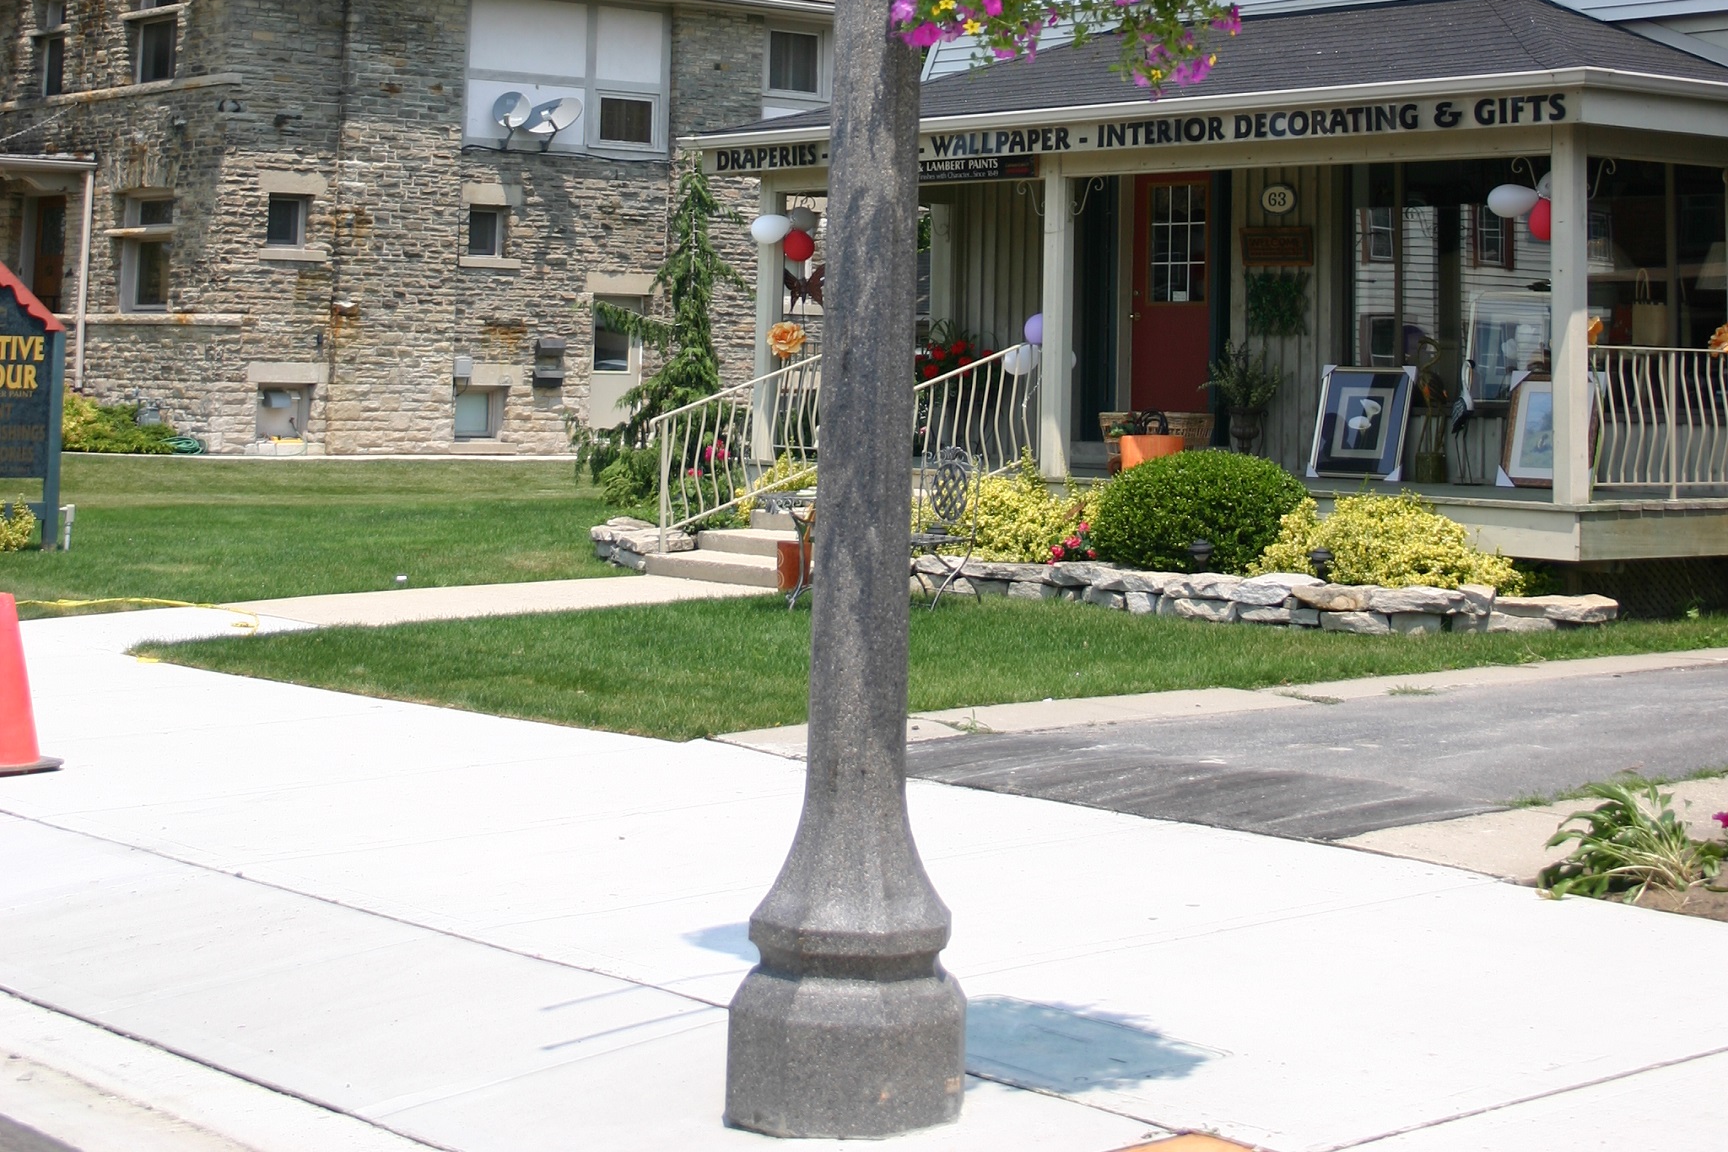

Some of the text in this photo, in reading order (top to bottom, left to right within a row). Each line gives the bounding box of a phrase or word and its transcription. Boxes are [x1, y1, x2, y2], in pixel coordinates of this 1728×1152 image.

[716, 144, 817, 171] DRAPERIES
[931, 127, 1069, 157] WALLPAPER
[1097, 116, 1225, 148] INTERIOR
[1234, 103, 1418, 139] DECORATING
[1433, 101, 1462, 128] &
[1473, 93, 1567, 126] GIFTS
[926, 160, 965, 172] LAMBERT
[968, 158, 999, 170] PAINTS
[1268, 192, 1287, 207] 63
